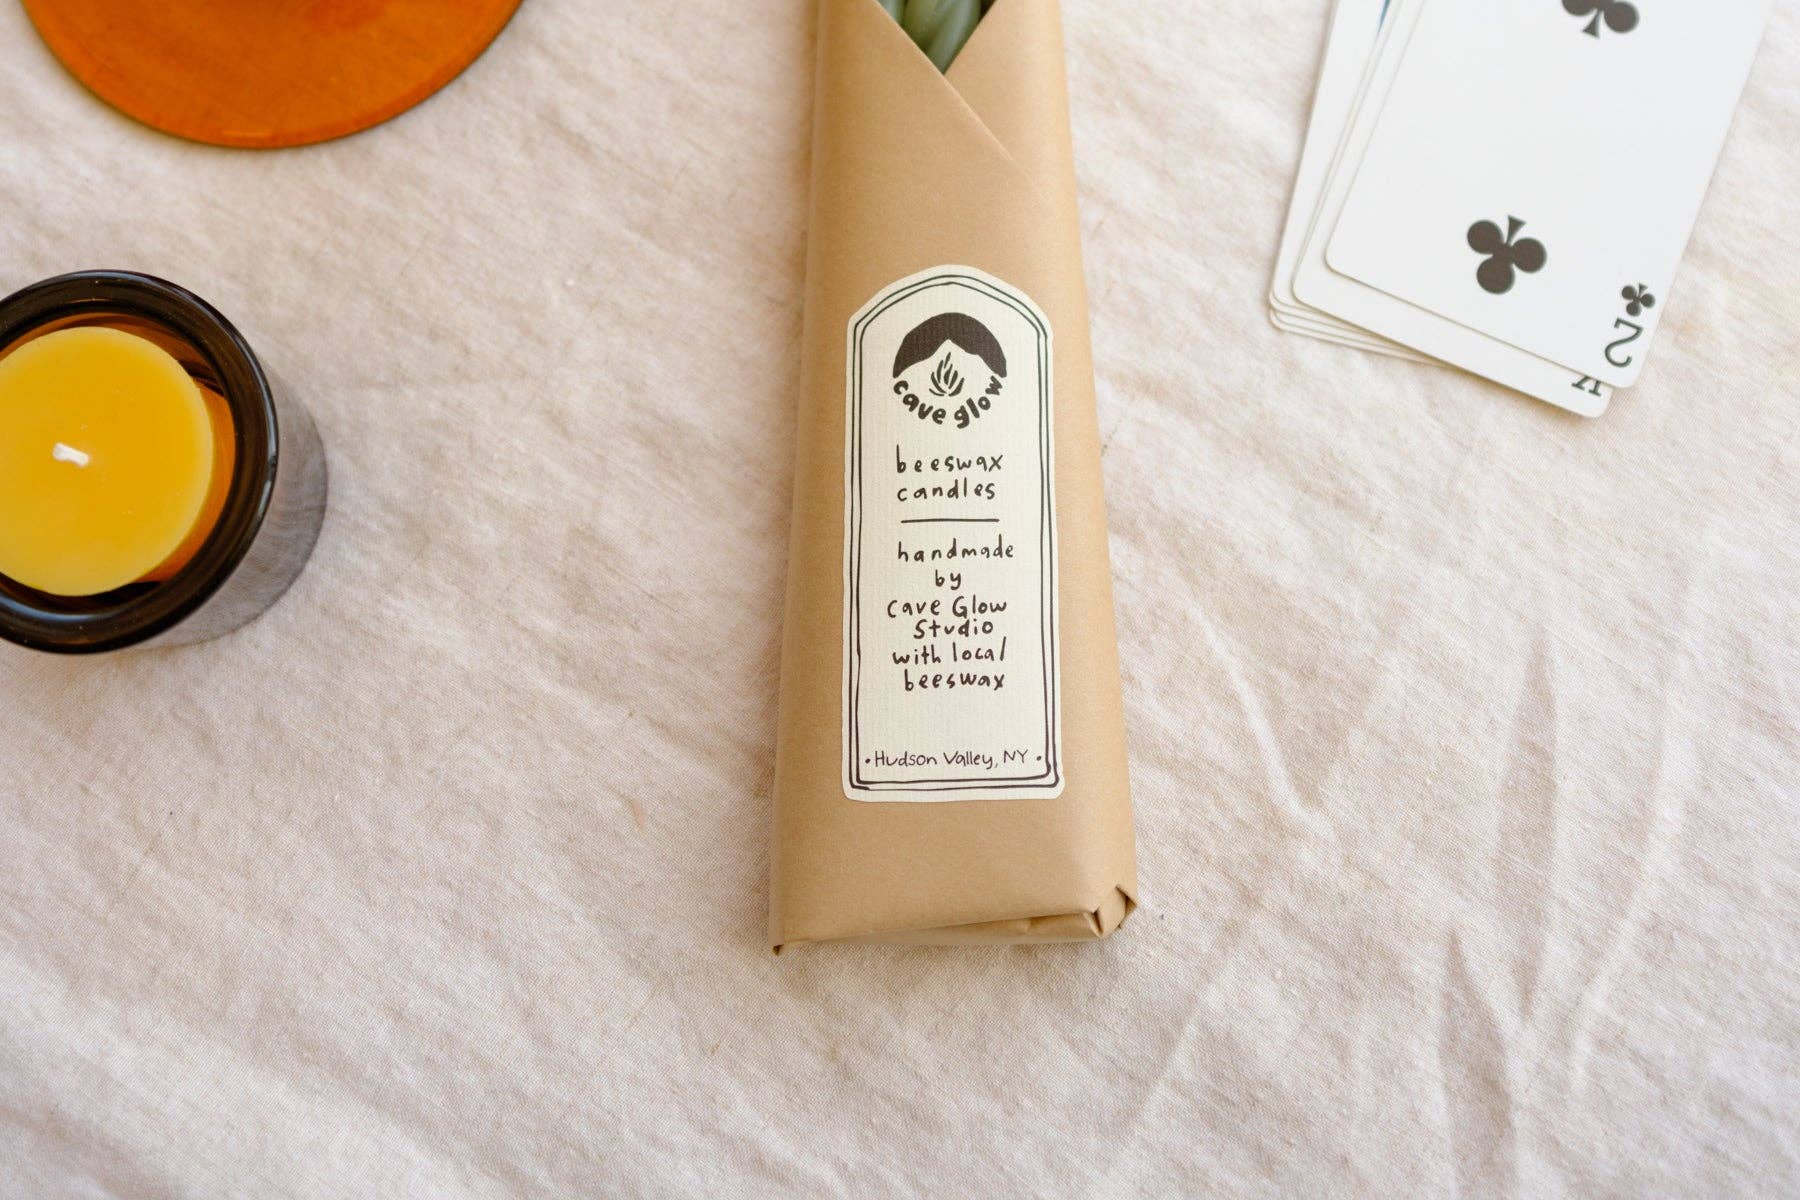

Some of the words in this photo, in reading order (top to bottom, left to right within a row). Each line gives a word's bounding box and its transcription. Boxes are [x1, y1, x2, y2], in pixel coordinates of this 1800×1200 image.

[1604, 317, 1643, 368] 2
[893, 380, 947, 425] cave
[954, 376, 1003, 429] glow
[896, 444, 1003, 473] beeswax
[897, 477, 995, 501] candles
[898, 534, 1013, 562] handmade
[935, 569, 961, 590] by
[952, 595, 1007, 618] Glow
[913, 618, 993, 639] Studio
[892, 644, 941, 665] with
[953, 636, 1007, 662] local
[904, 669, 1004, 691] beeswax
[875, 751, 937, 767] Hudson
[1003, 750, 1028, 762] NY
